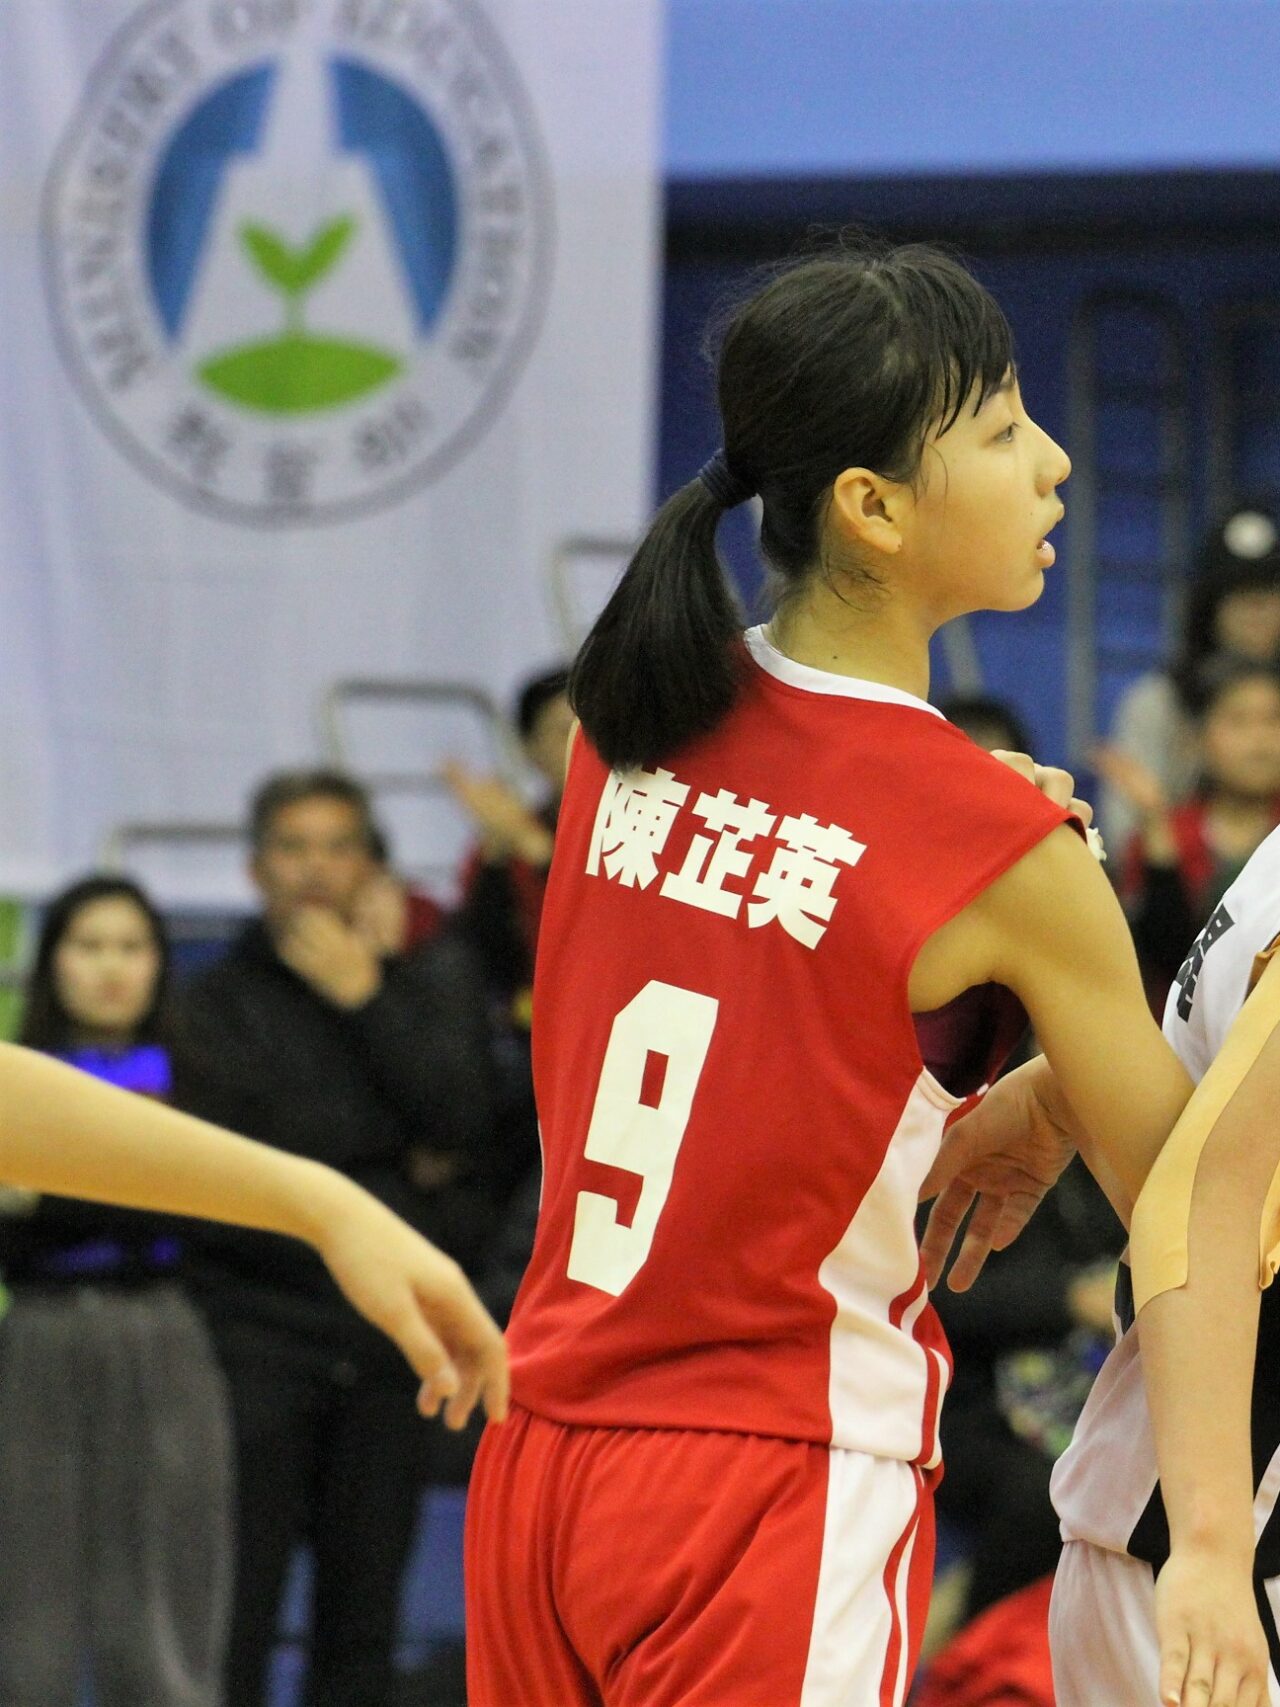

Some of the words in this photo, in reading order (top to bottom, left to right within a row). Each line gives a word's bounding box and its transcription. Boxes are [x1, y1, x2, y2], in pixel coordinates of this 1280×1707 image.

[585, 766, 867, 950] 陳芷英
[567, 980, 719, 1297] 9
